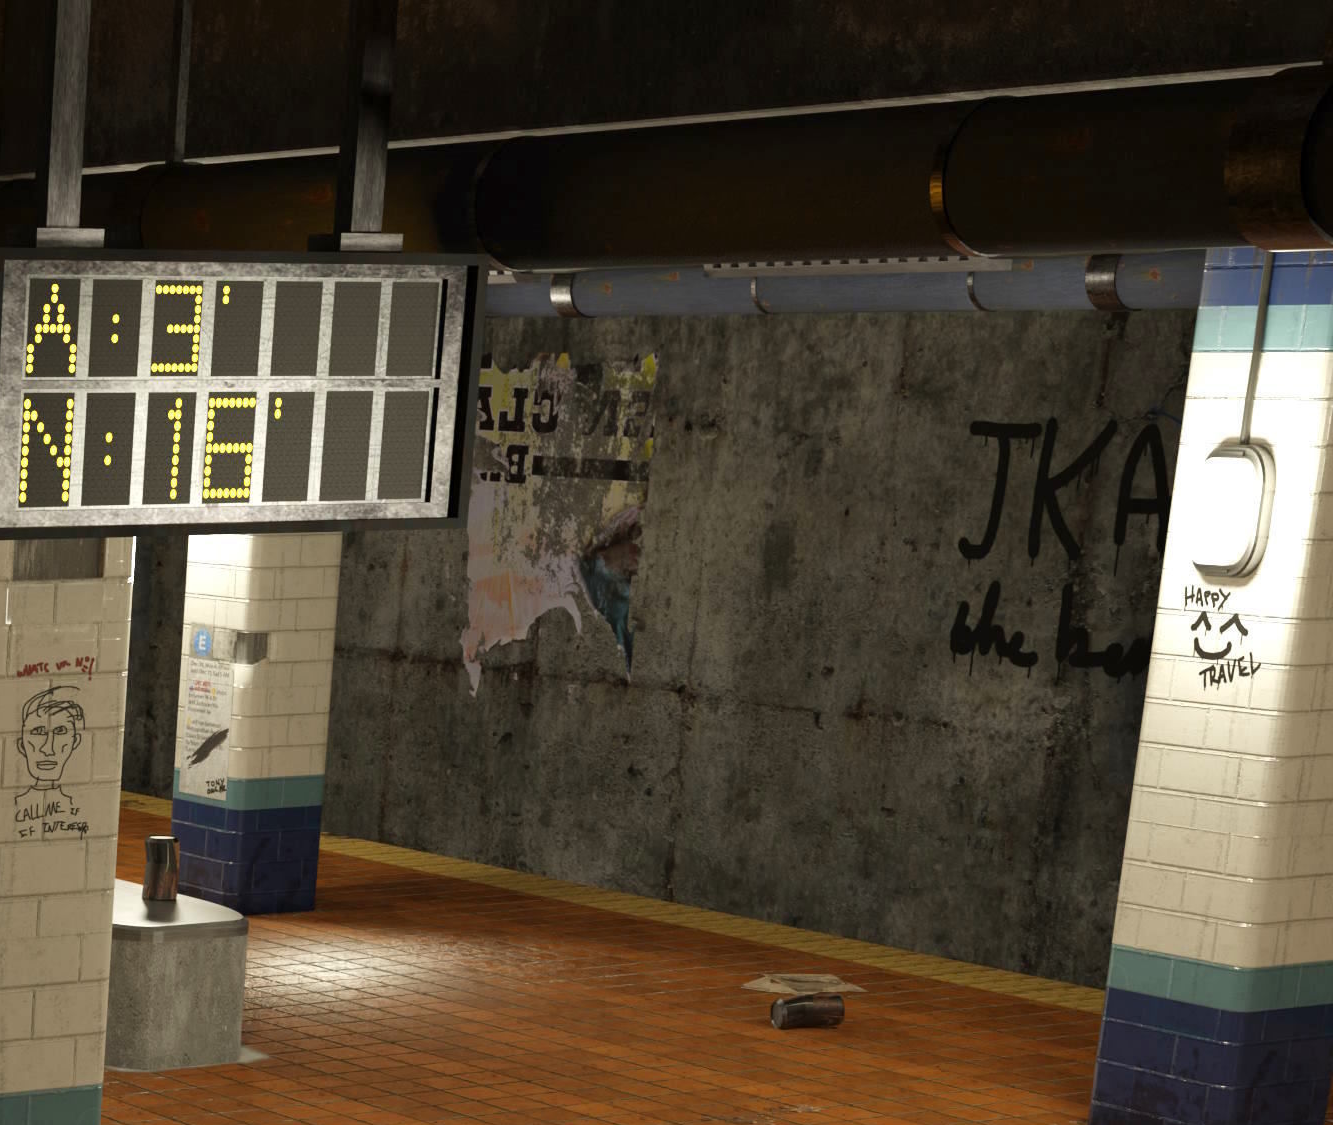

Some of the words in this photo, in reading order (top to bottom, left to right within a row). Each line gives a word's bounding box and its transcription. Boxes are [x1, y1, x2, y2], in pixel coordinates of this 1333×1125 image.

[1184, 585, 1231, 611] HAPPY
[1198, 652, 1261, 690] TRAVEL
[14, 803, 44, 822] CALL
[45, 801, 67, 817] ME
